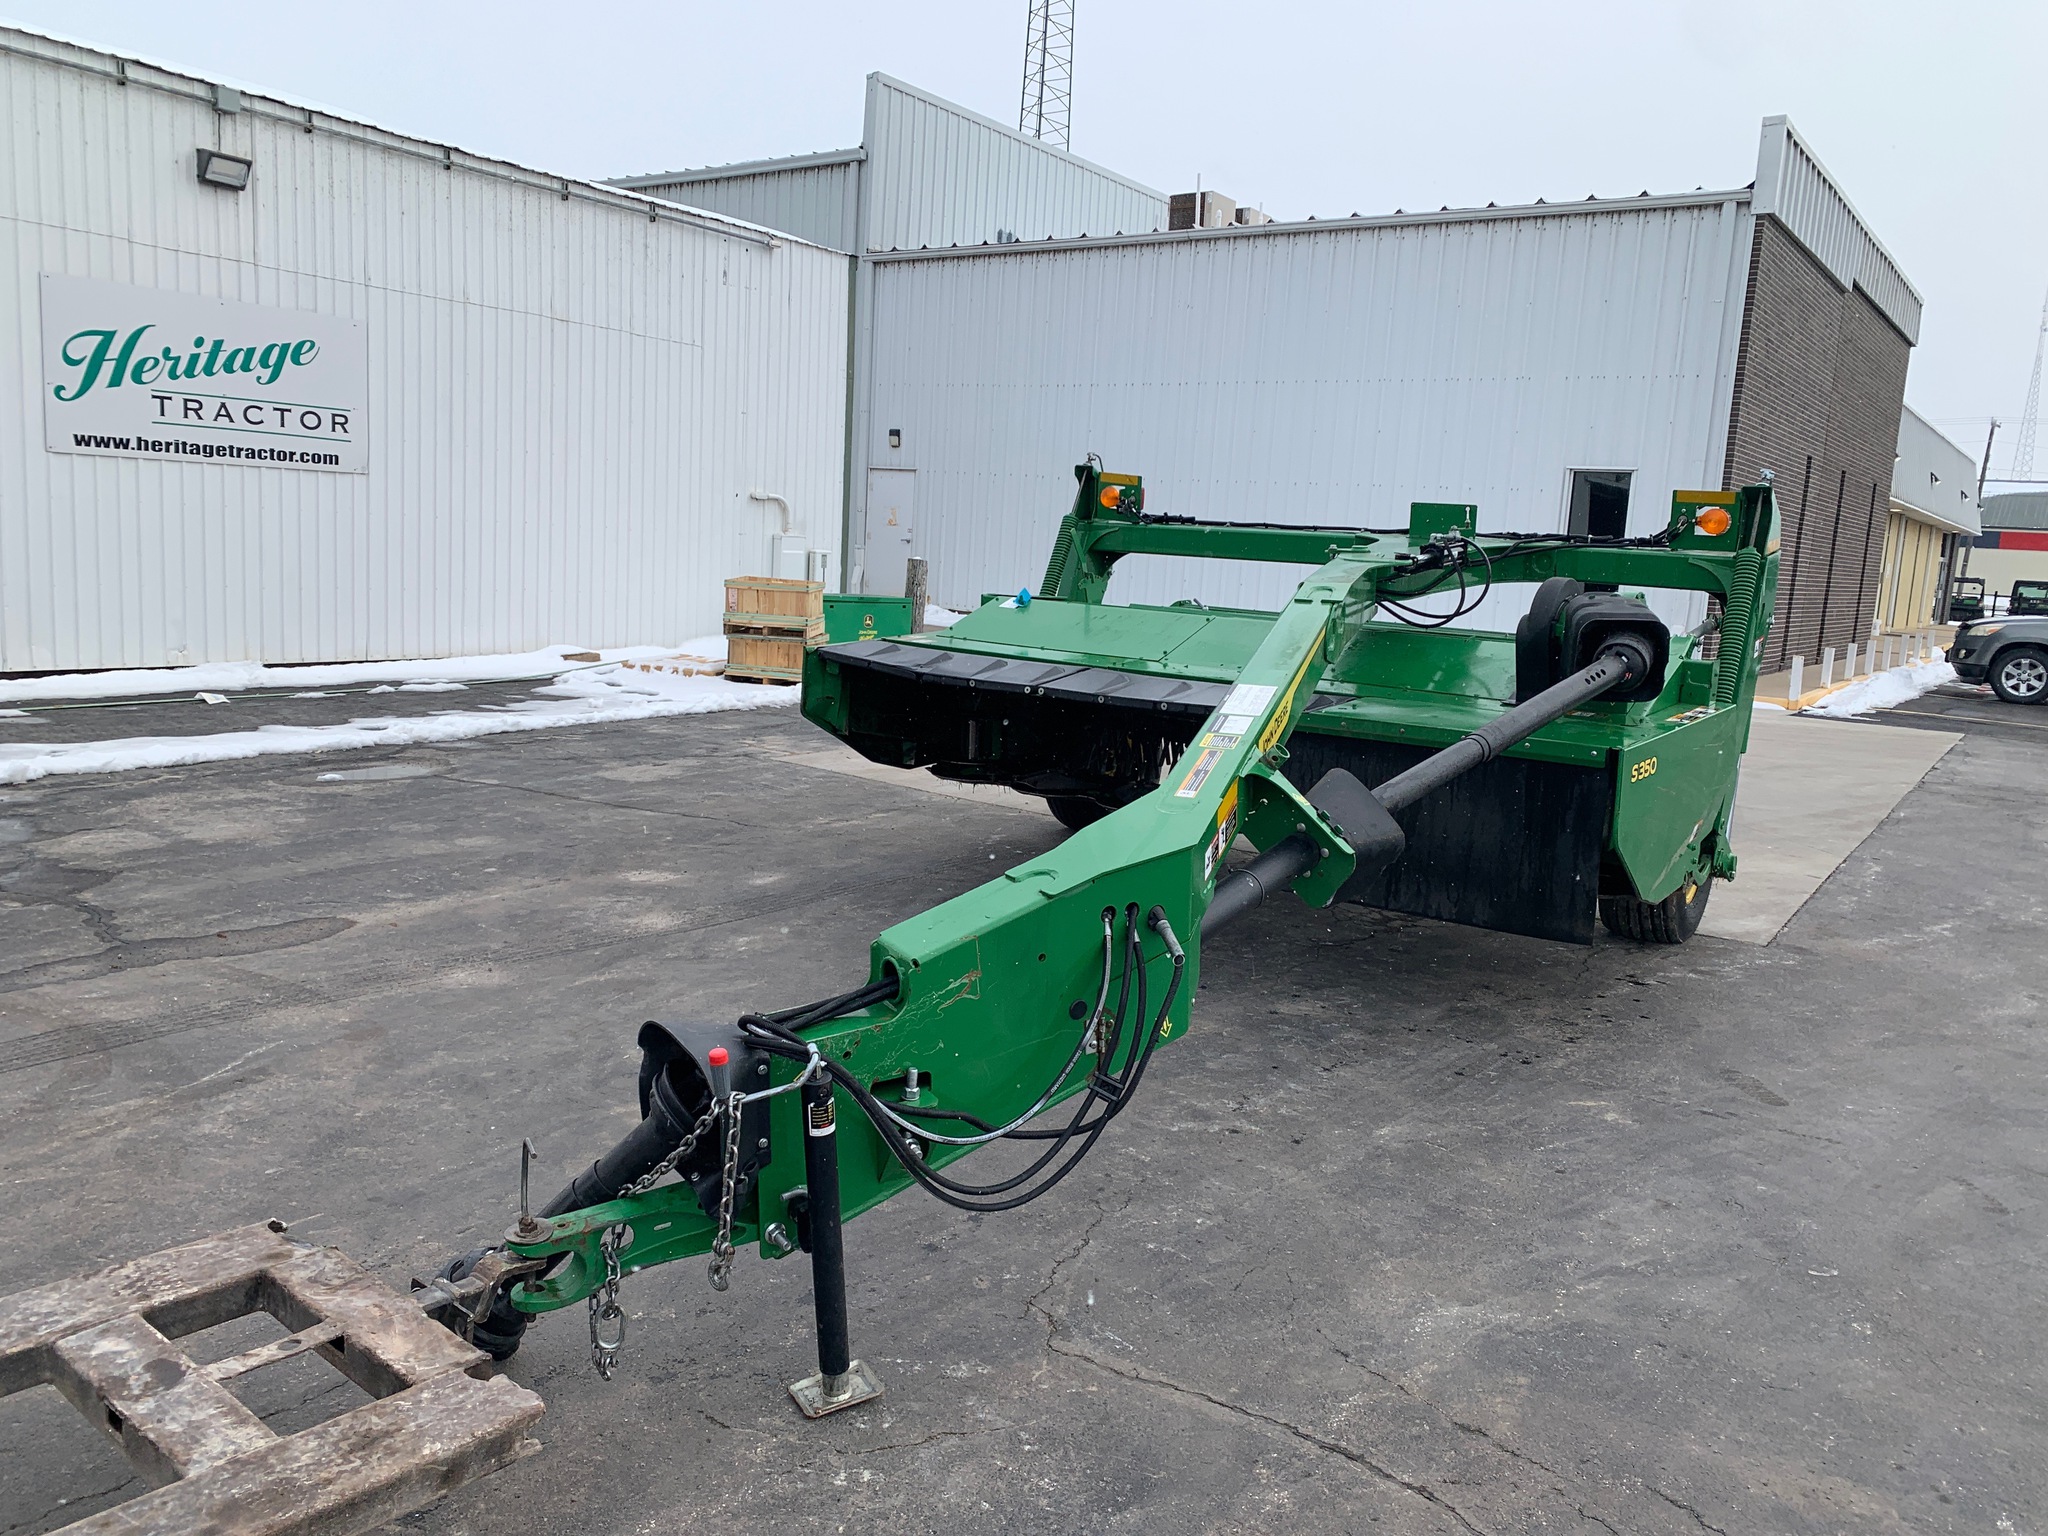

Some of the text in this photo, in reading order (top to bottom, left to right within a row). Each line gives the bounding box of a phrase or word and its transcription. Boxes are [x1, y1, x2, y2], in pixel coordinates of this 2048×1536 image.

[53, 324, 320, 402] Heritage
[151, 394, 350, 434] TRACTOR
[73, 433, 340, 466] www.heritagetractor.com
[1630, 756, 1658, 783] S350
